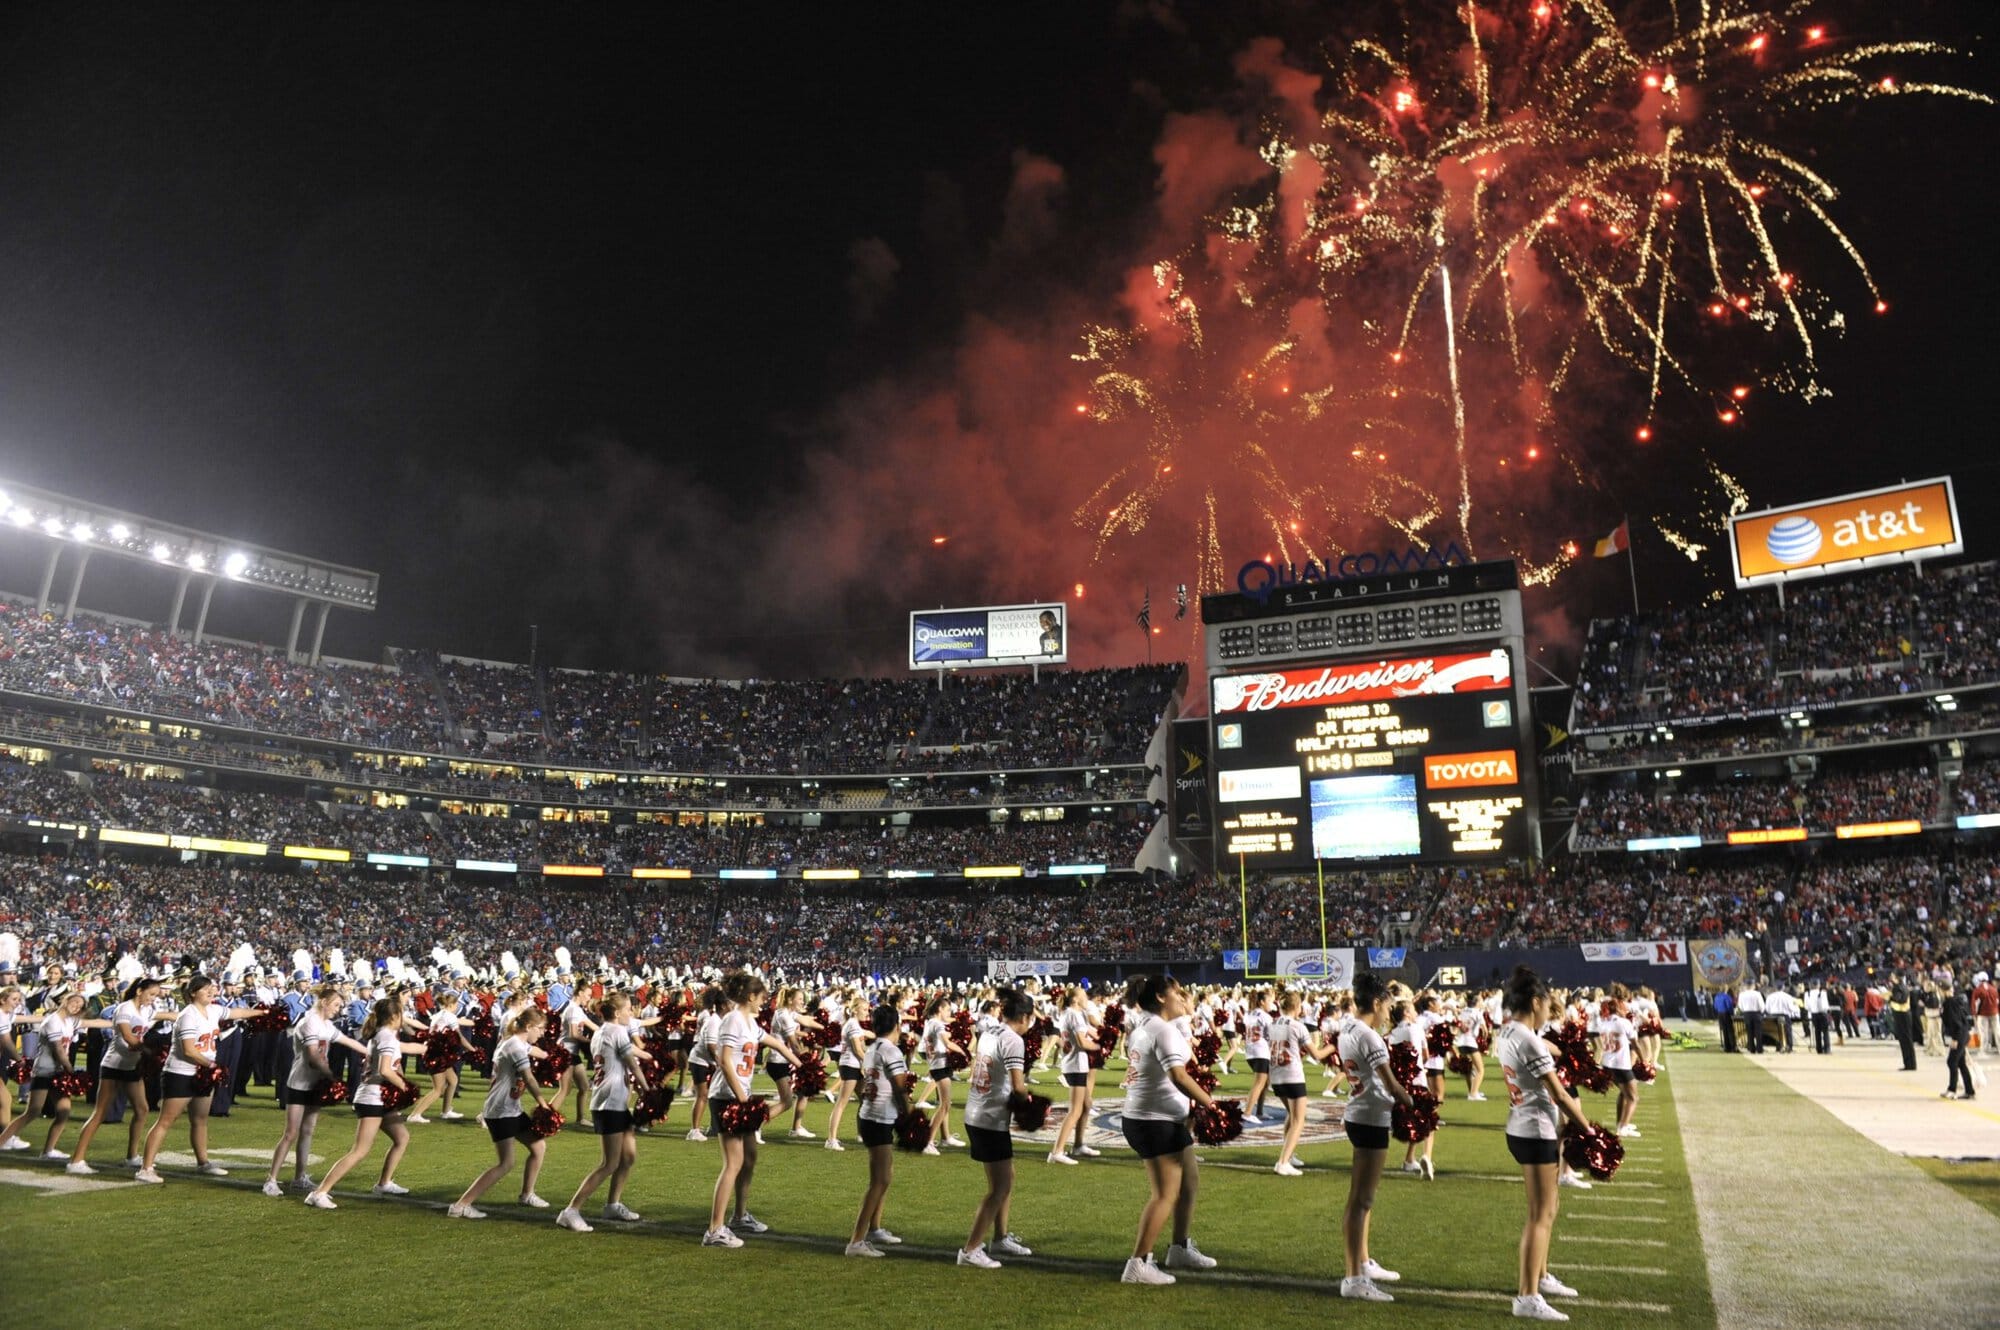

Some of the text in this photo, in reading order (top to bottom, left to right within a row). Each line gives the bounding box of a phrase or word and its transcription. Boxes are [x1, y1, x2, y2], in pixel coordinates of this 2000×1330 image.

[1832, 501, 1925, 547] at&t
[1237, 541, 1467, 606] QUALCOMM
[1285, 574, 1449, 603] STADIUM
[917, 627, 984, 643] QUALCOMM
[1243, 659, 1434, 711] Budweiser
[1373, 702, 1390, 716] TO
[1315, 715, 1401, 736] DR PEPPER
[1295, 732, 1378, 752] HALFTIME
[1385, 728, 1430, 745] SHOW
[1429, 759, 1513, 781] TOYOTA
[1176, 777, 1206, 791] Sprint
[1294, 955, 1320, 965] PACIFIC
[1656, 943, 1679, 962] N
[994, 962, 1010, 980] A
[1441, 967, 1464, 985] 25
